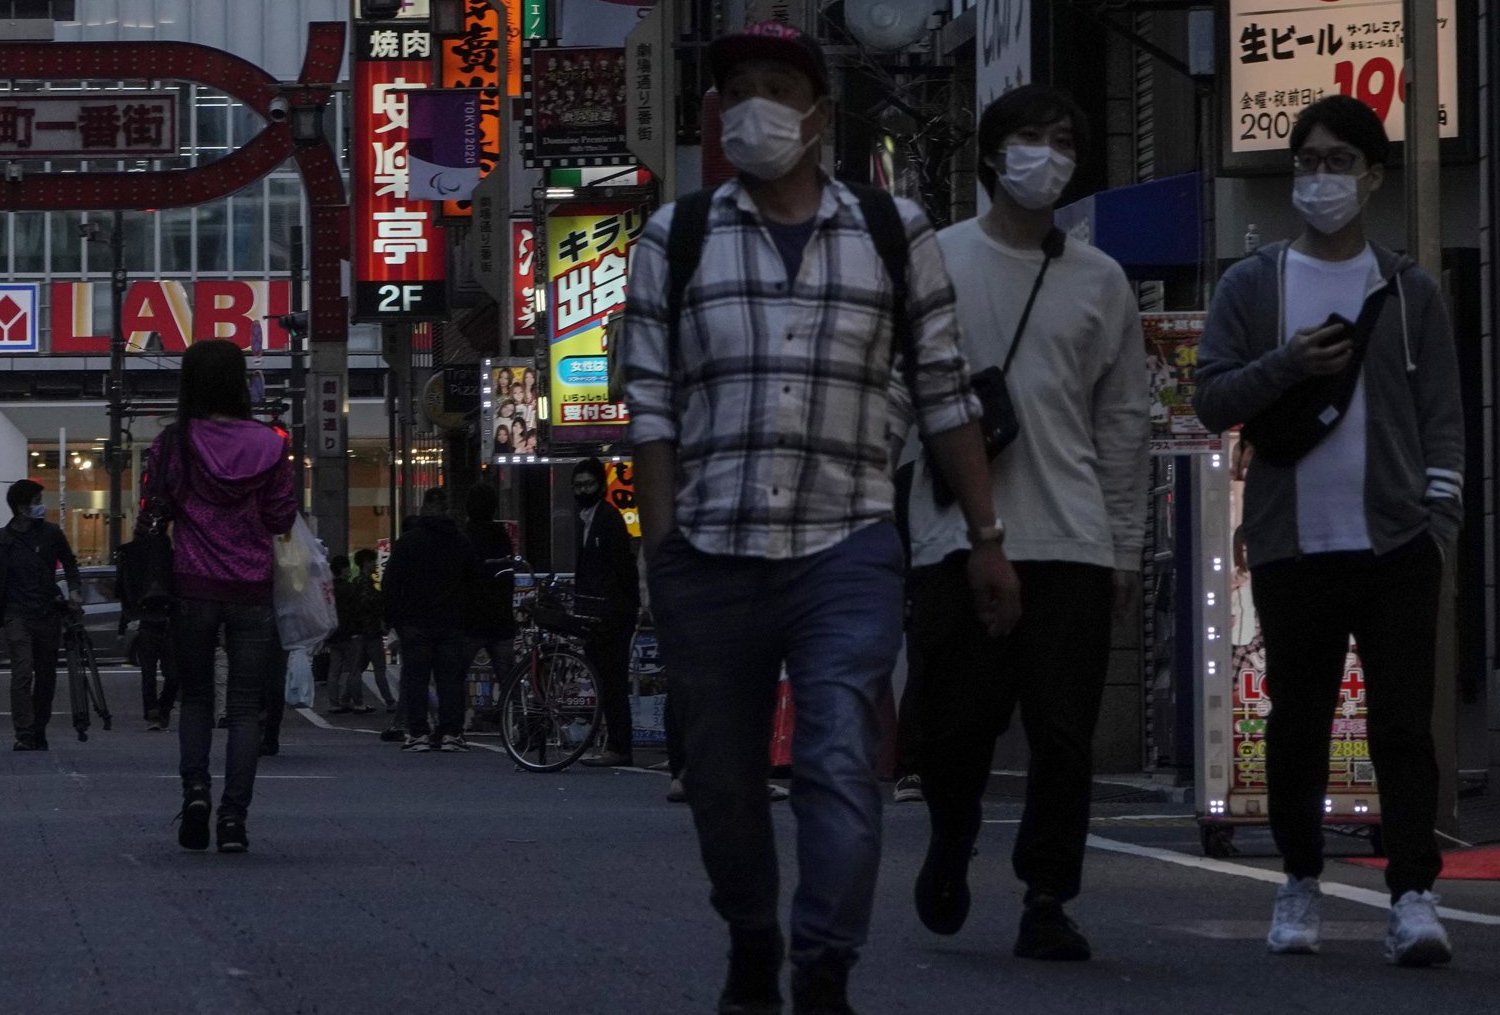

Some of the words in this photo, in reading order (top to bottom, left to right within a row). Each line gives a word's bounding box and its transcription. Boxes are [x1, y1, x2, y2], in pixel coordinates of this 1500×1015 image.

[369, 29, 432, 59] 焼肉
[1238, 22, 1344, 65] 生ビール
[463, 99, 476, 134] TOKYO
[463, 136, 476, 166] 2020
[377, 284, 424, 312] 2F
[51, 280, 291, 353] LABI
[322, 379, 337, 451] 劇場通り
